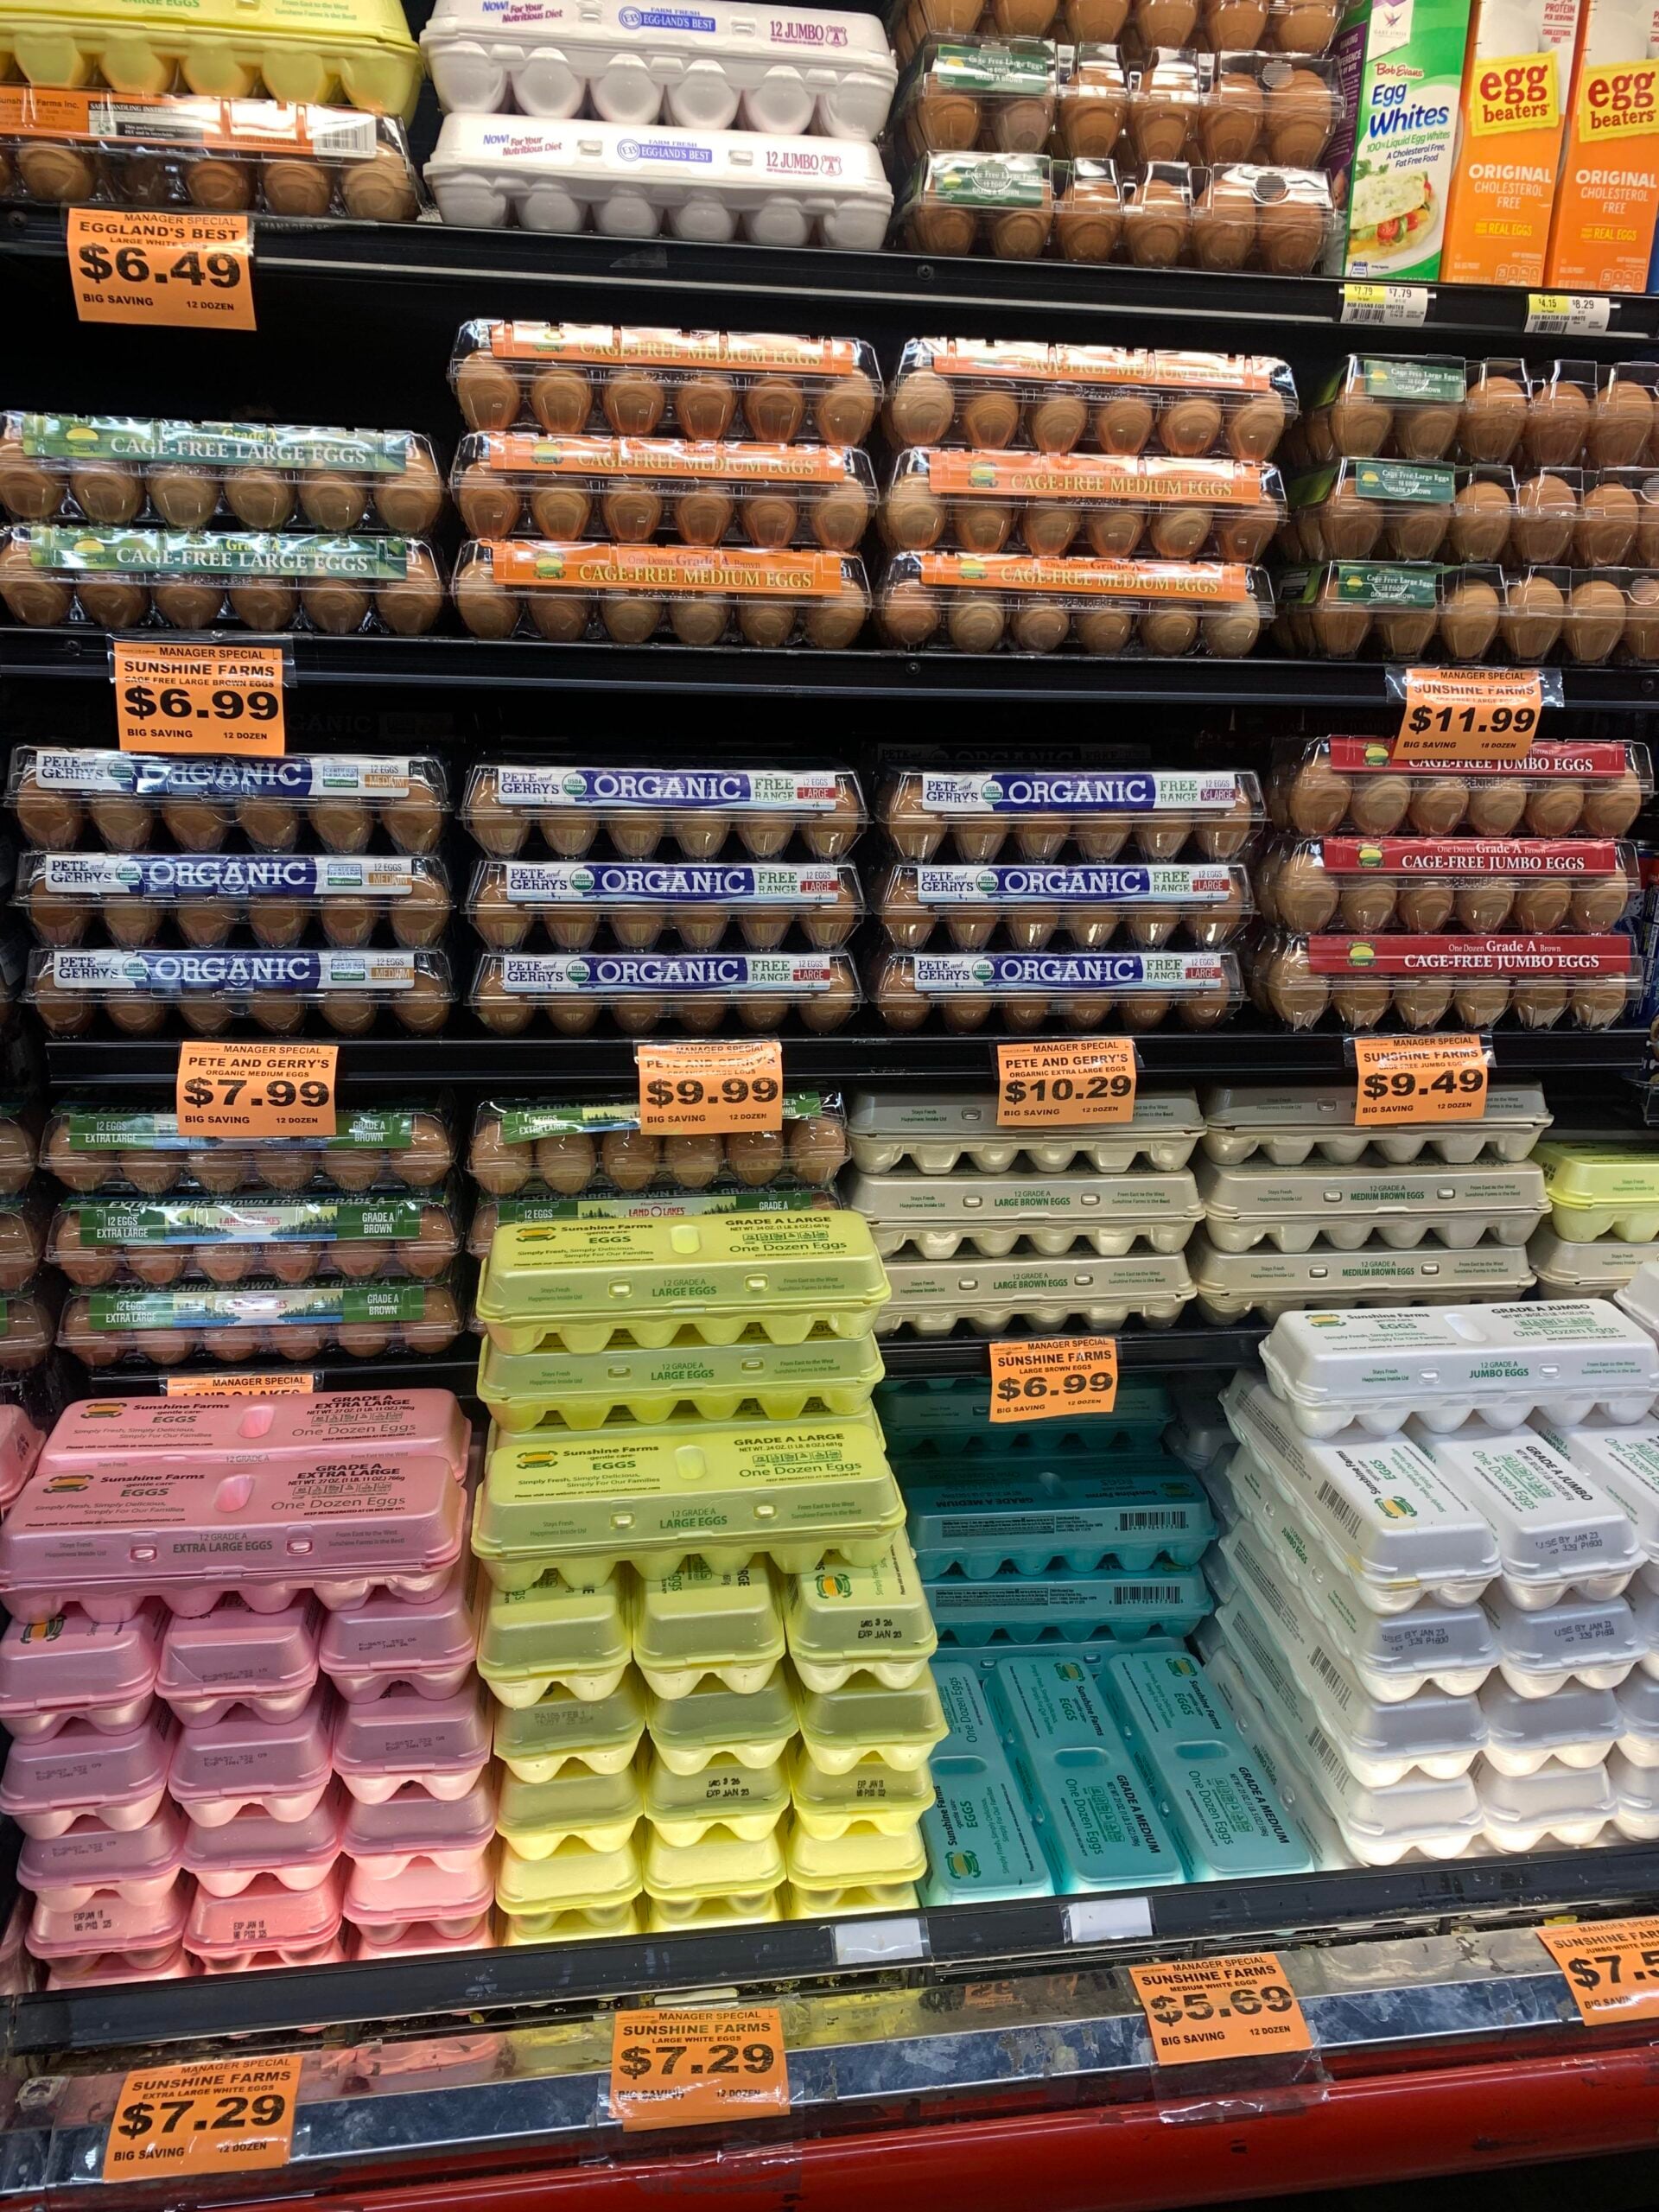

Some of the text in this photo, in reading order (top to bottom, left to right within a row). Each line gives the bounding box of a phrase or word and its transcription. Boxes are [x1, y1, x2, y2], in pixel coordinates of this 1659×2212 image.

[1375, 63, 1424, 77] Bob Evans
[1480, 65, 1548, 105] egg
[1588, 72, 1656, 111] egg
[1372, 84, 1407, 106] Egg
[1370, 104, 1449, 138] Whites
[1483, 104, 1548, 123] beaters
[1591, 110, 1655, 129] beaters
[525, 136, 543, 145] Your
[1386, 131, 1450, 150] Liquid Egg Whites
[502, 142, 563, 156] Nutritious Diet
[689, 149, 709, 162] BEST
[766, 151, 818, 169] 12 JUMBO
[1408, 157, 1421, 166] Free
[1469, 164, 1551, 183] ORIGINAL
[1576, 170, 1656, 188] ORIGINAL
[1474, 181, 1543, 197] CHOLESTEROL
[1497, 196, 1521, 209] FREE
[124, 213, 183, 224] MANAGER
[188, 217, 237, 226] SPECIAL
[79, 221, 239, 239] EGGLAND'S BEST
[1489, 221, 1532, 236] REAL EGGS
[79, 243, 241, 288] $6.49
[1355, 287, 1373, 296] $7.79
[1389, 289, 1412, 298] $7.79
[83, 294, 153, 306] BIG SAVING
[200, 302, 234, 310] DOZEN
[1573, 299, 1594, 309] $8.29
[116, 548, 368, 572] CAGE-FREE LARGE EGGS
[579, 565, 812, 588] CAGE-FREE MEDIUM EGGS
[159, 647, 265, 659] MANAGER SPECIAL
[124, 662, 275, 677] SUNSHINE FARMS
[124, 685, 279, 721] $6.99
[1408, 705, 1535, 734] $11.99
[594, 776, 741, 800] ORGANIC
[1008, 781, 1147, 803] ORGANIC
[1203, 790, 1234, 800] X-LARGE
[1437, 845, 1452, 854] One
[1453, 845, 1475, 854] Dozen
[1476, 843, 1510, 854] Grade
[1513, 844, 1522, 854] A
[1402, 855, 1585, 872] CAGE-FREE JUMBO EGGS
[149, 861, 307, 886] ORGANIC
[511, 869, 545, 880] PETE
[601, 869, 747, 893] ORGANIC
[758, 872, 798, 883] FREE
[758, 884, 798, 893] RANGE
[805, 881, 831, 892] LARGE
[1404, 955, 1599, 969] CAGE-FREE JUMBO EGGS
[188, 1057, 329, 1069] PETE AND GERRY'S
[1006, 1053, 1128, 1069] PETE AND GERRY'S
[1005, 1075, 1132, 1105] $10.29
[1363, 1069, 1484, 1100] $9.49
[183, 1077, 329, 1109] $7.99
[646, 1077, 778, 1109] $9.99
[994, 1197, 1071, 1207] LARGE BROWN EGGS
[107, 1217, 137, 1226] 12 EGGS
[362, 1212, 394, 1223] GRADE A
[96, 1229, 149, 1237] EXTRA LARGE
[364, 1224, 392, 1234] BROWN
[652, 1286, 716, 1297] LARGE EGGS
[998, 1351, 1111, 1366] SUNSHINE FARMS
[1469, 1369, 1529, 1379] JUMBO EGGS
[997, 1372, 1113, 1402] $6.99
[734, 1436, 781, 1446] GRADE
[798, 1433, 845, 1442] LARGE
[592, 1460, 636, 1471] EGGS
[739, 1460, 861, 1478] One Dozen Eggs
[173, 1541, 272, 1554] EXTRA LARGE EGGS
[1535, 1538, 1557, 1548] USE
[1573, 1534, 1587, 1542] JAN
[1238, 1766, 1290, 1844] GRADE A MEDIUM
[1554, 1933, 1628, 1948] SUNSHINE
[1141, 1965, 1277, 1986] SUNSHINE FARMS
[1150, 1986, 1293, 2027] $5.69
[619, 2044, 774, 2080] $7.29
[132, 2071, 291, 2091] SUNSHINE FARMS
[118, 2094, 285, 2140] $7.29
